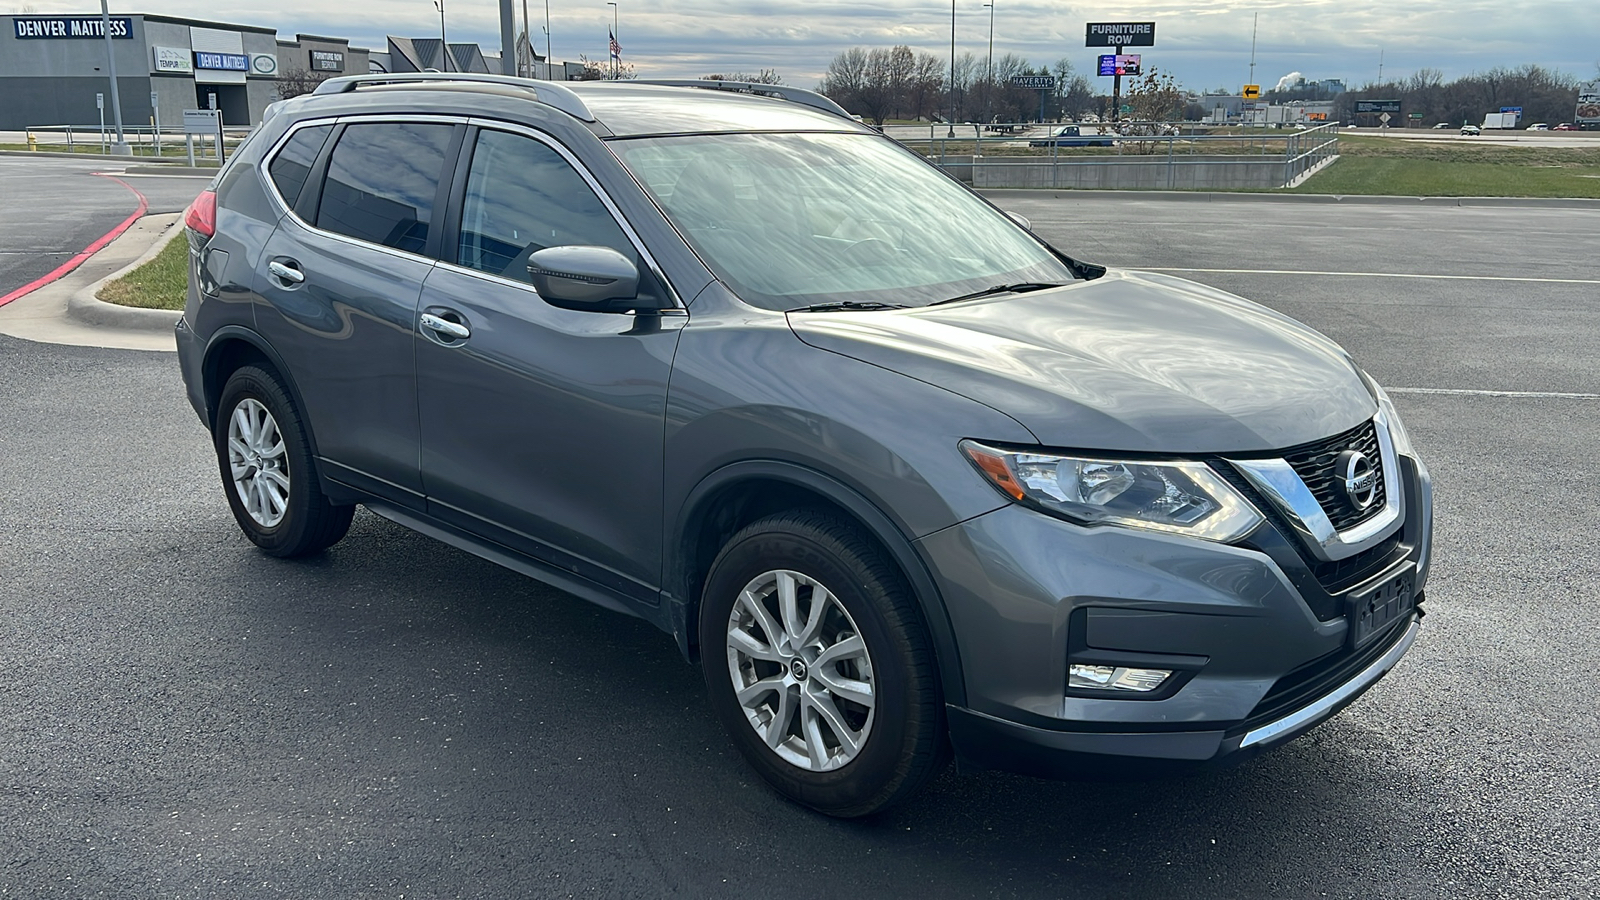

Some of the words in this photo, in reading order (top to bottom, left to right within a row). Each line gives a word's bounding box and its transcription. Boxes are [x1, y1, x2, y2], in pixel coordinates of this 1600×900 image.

[17, 20, 67, 36] DENVER
[1091, 24, 1151, 34] FURNITURE
[1107, 35, 1133, 44] ROW
[200, 53, 221, 67] DENVER
[222, 54, 245, 69] MATTRESS
[313, 51, 334, 61] FURNITURE
[334, 53, 343, 62] ROW
[1013, 77, 1053, 85] HAVERTYS
